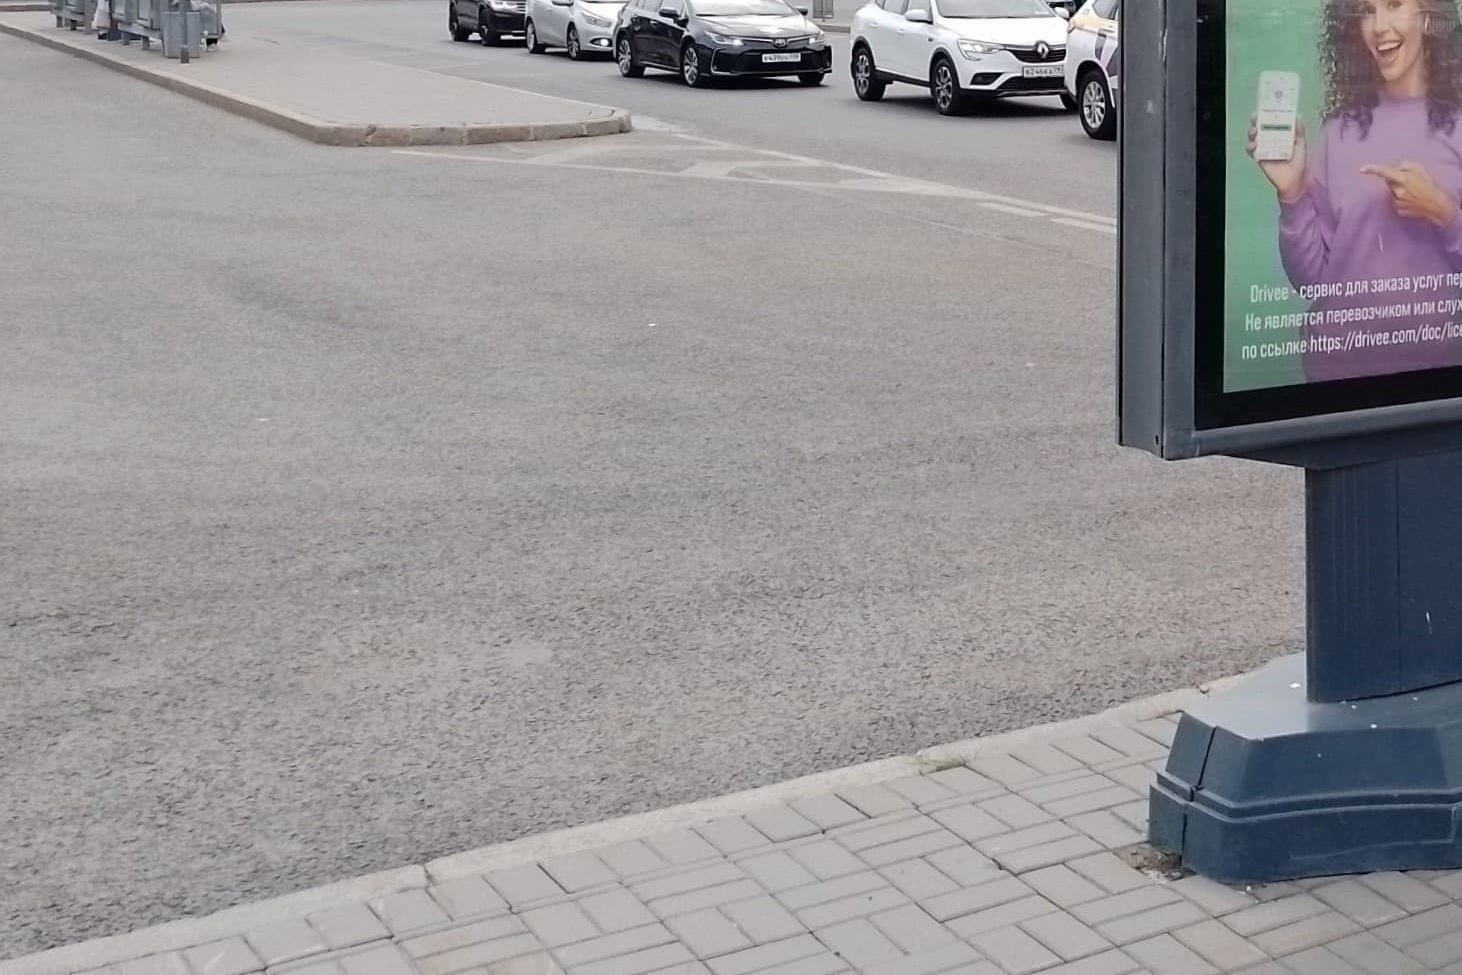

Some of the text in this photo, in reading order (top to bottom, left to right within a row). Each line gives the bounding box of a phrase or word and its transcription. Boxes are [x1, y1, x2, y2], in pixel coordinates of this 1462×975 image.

[1250, 284, 1289, 304] Drivee
[1299, 283, 1343, 301] сервис
[1344, 280, 1369, 297] для
[1370, 277, 1410, 293] заказа
[1412, 273, 1445, 293] услуг
[1245, 313, 1262, 332] Не
[1264, 309, 1324, 329] является
[1325, 304, 1412, 326] перевозчиком
[1413, 300, 1436, 316] или
[1241, 346, 1258, 360] по
[1260, 339, 1307, 358] ссылке
